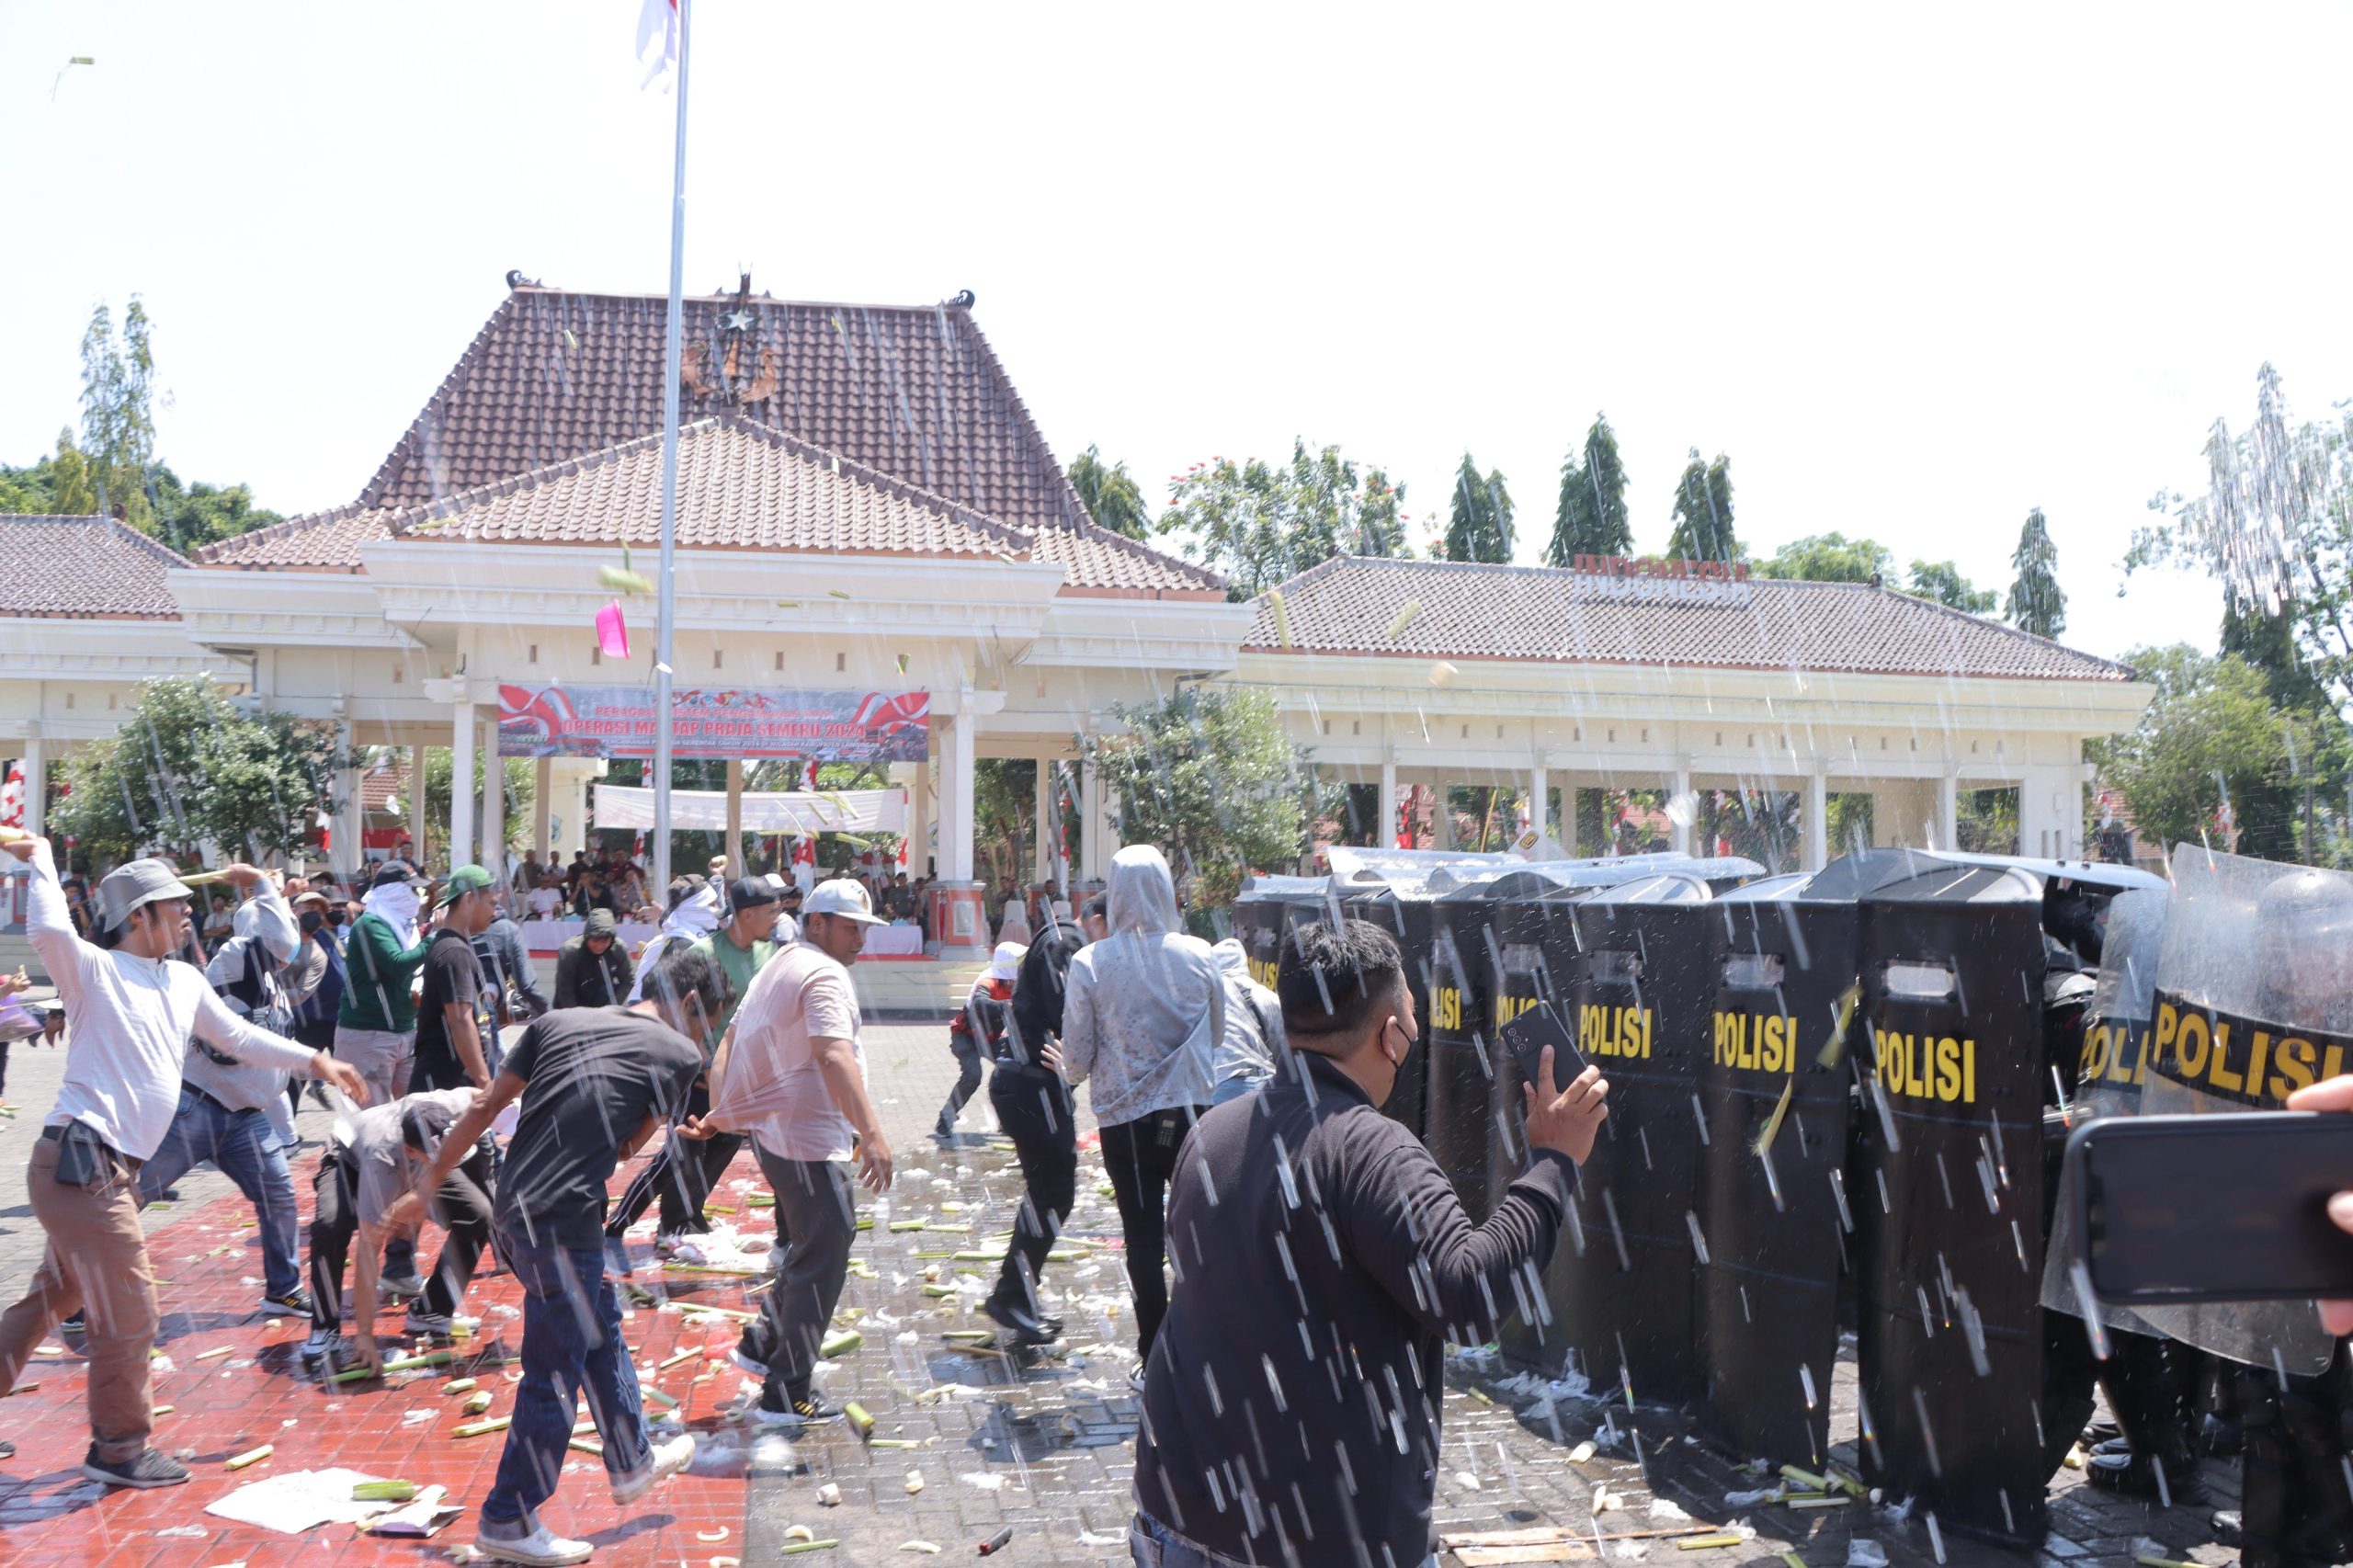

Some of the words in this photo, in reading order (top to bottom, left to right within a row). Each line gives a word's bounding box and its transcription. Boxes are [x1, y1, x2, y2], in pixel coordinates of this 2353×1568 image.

[1574, 553, 1751, 604] INDONESIA
[563, 719, 631, 735] OPERASI
[634, 720, 700, 736] MATAP
[703, 721, 754, 737] PRAJA
[756, 722, 821, 738] SEMERU
[824, 722, 867, 739] 2024
[595, 707, 656, 717] PERAGAA
[1578, 1004, 1653, 1059] POLISI
[1713, 1011, 1798, 1074] POLISI
[1875, 1028, 1975, 1103] POLISI
